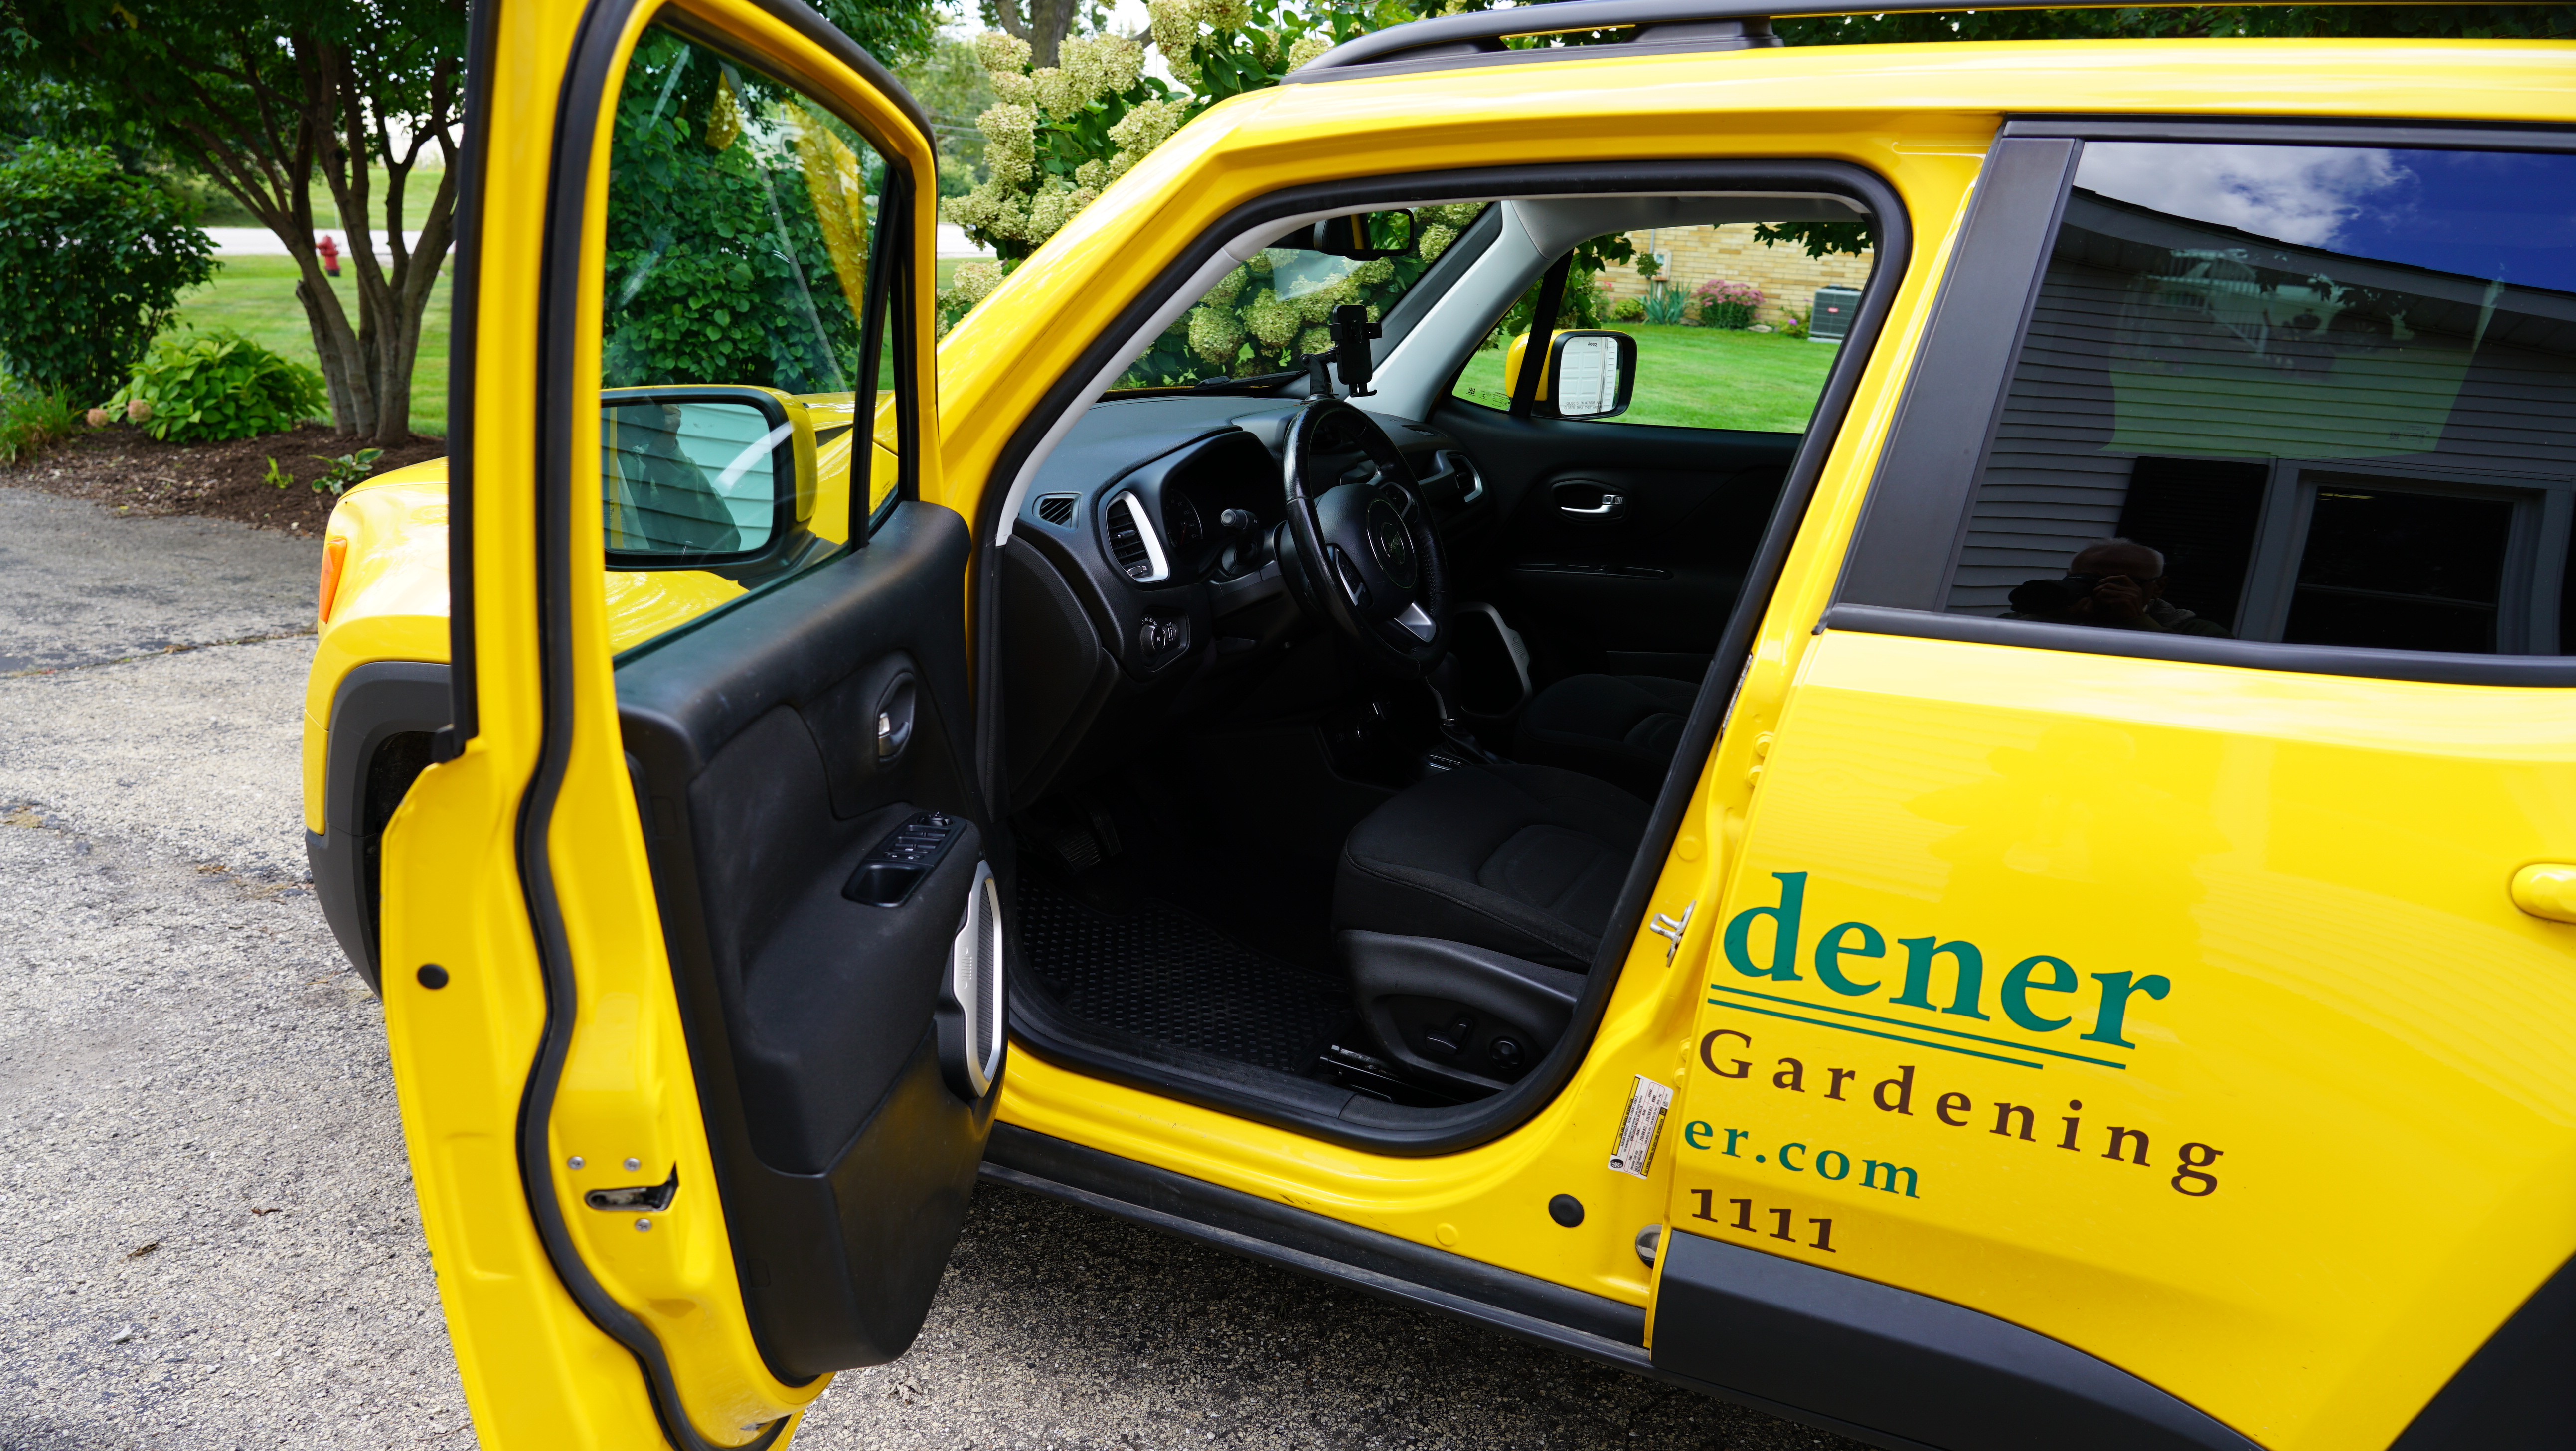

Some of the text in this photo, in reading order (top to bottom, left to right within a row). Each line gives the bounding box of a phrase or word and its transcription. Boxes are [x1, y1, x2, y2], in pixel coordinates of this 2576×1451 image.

[1724, 871, 2171, 1049] dener
[1685, 1120, 1920, 1199] er.com
[1700, 1029, 2224, 1197] Gardening
[1690, 1189, 1837, 1253] 1111
